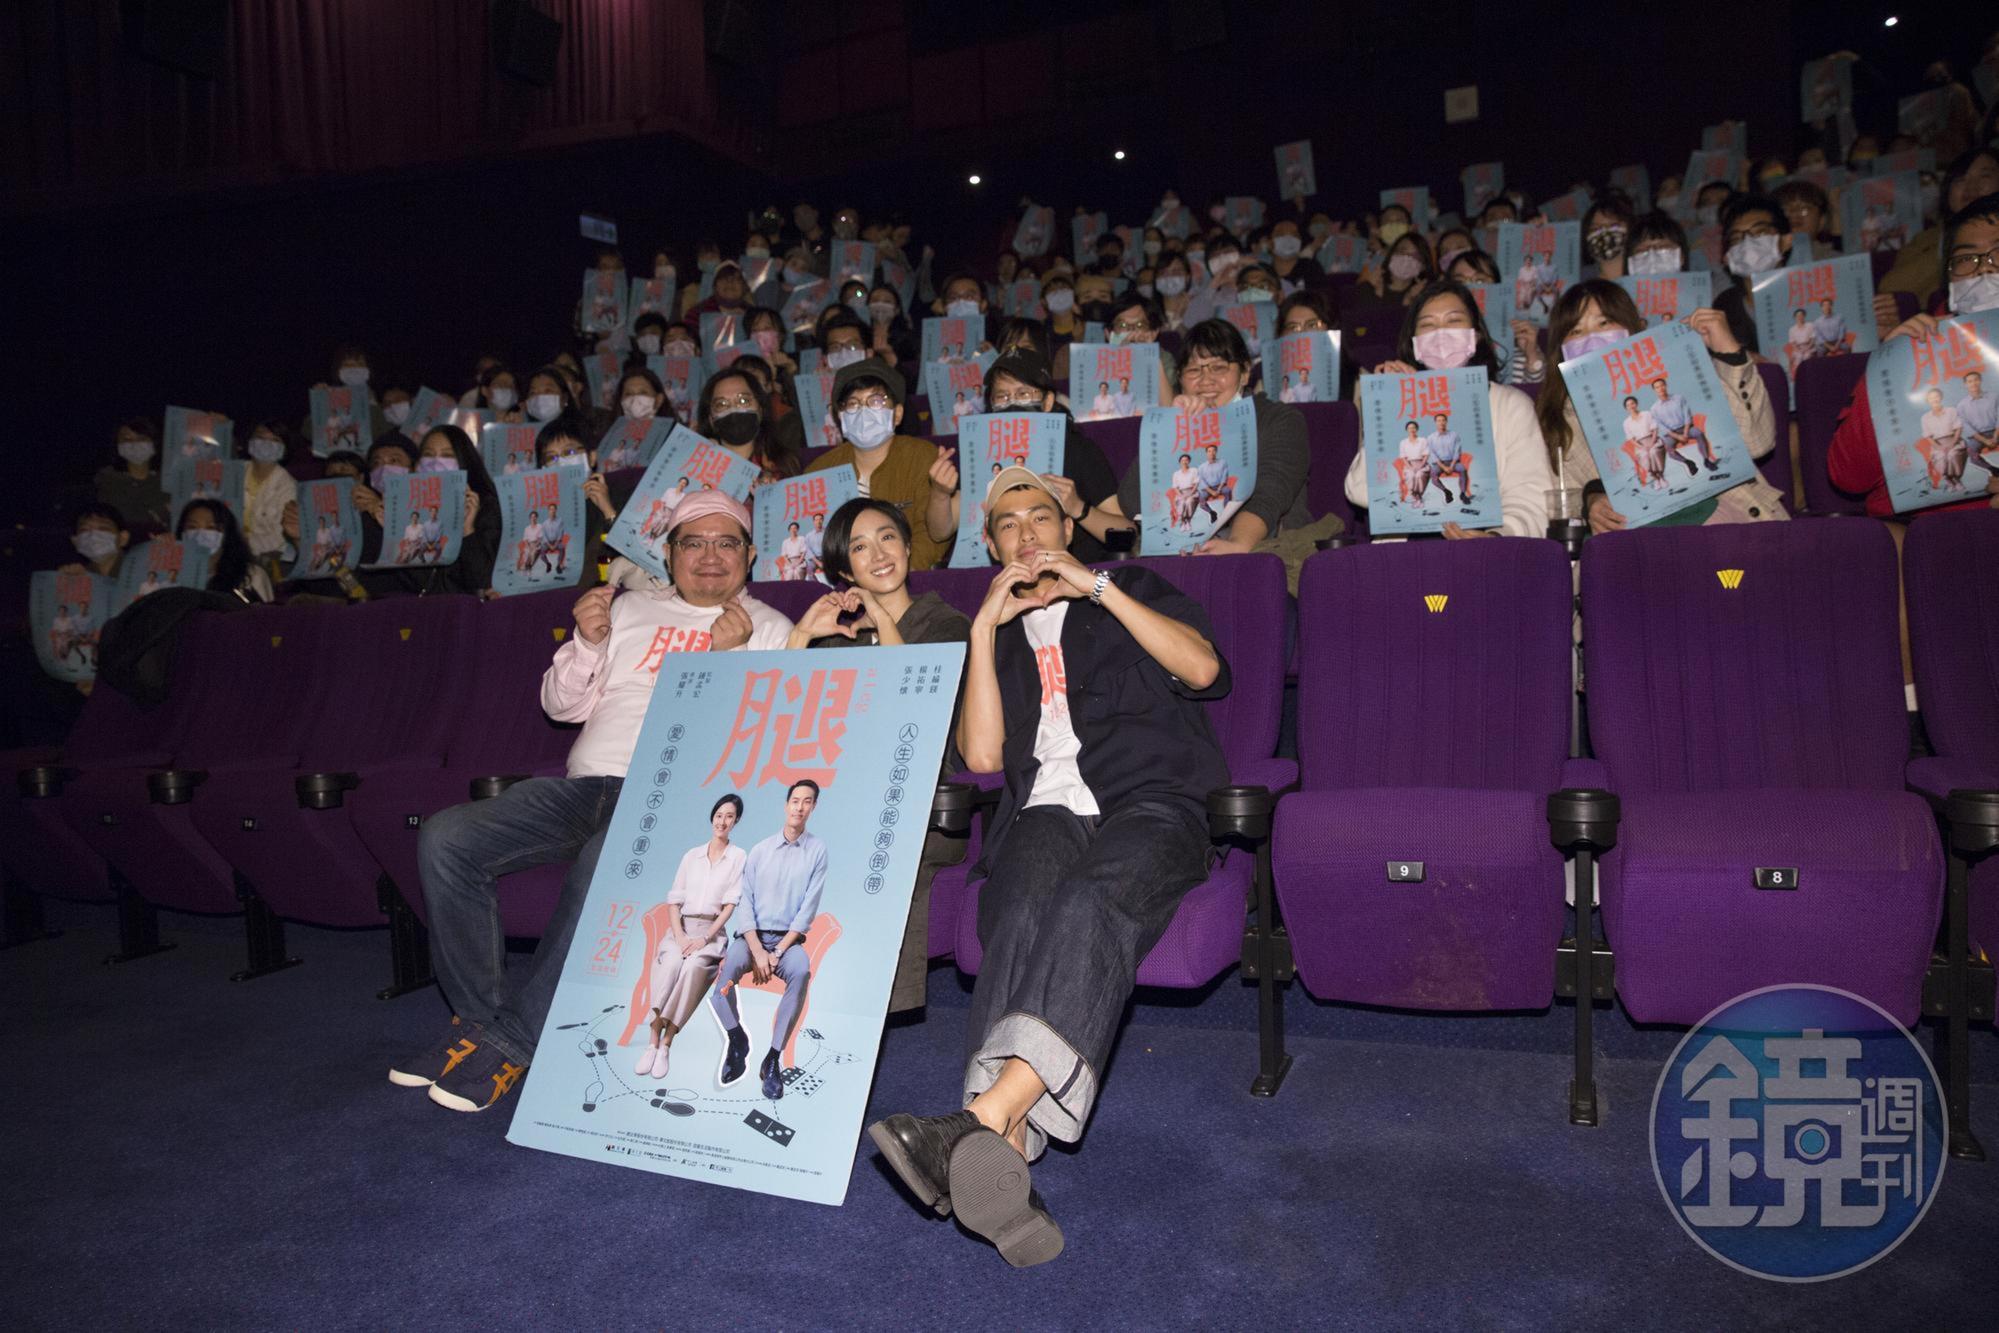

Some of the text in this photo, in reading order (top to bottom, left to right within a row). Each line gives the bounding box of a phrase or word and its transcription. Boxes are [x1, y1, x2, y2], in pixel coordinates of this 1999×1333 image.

[1601, 336, 1669, 400] 腿
[1397, 376, 1452, 421] 腿
[985, 418, 1030, 463] 腿
[1172, 412, 1223, 454] 腿
[681, 441, 732, 490] 腿
[784, 477, 830, 522] 腿
[701, 669, 858, 789] 腿
[625, 724, 685, 880] 愛情會不會重來
[864, 722, 919, 895] 人生如果能夠倒帶
[1400, 865, 1409, 876] 9
[1772, 871, 1783, 884] 8
[607, 903, 634, 930] 12
[593, 936, 623, 962] 24
